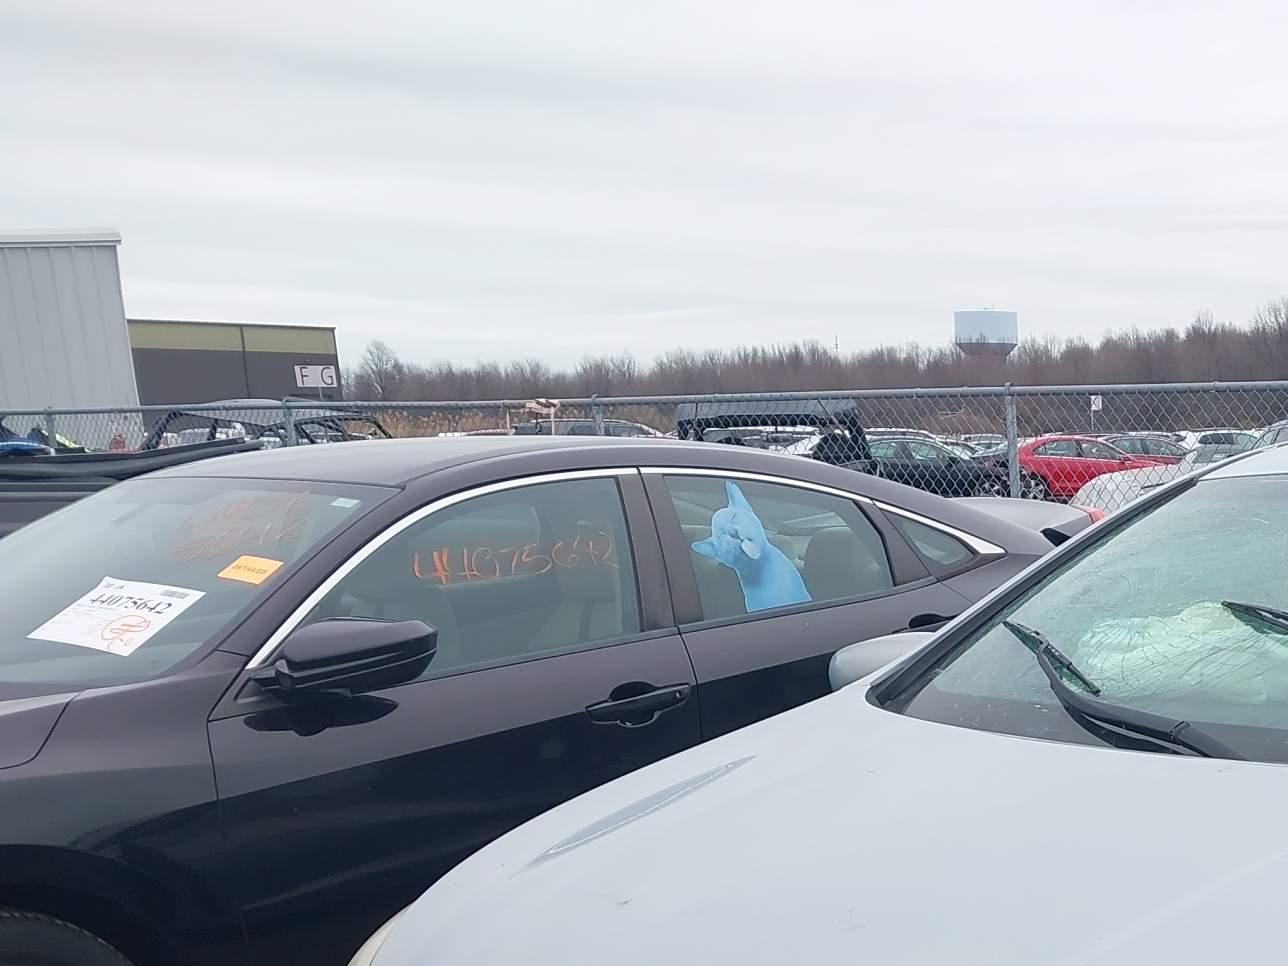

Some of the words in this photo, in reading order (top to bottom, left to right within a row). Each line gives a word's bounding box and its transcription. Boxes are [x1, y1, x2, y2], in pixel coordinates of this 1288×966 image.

[299, 366, 310, 386] F
[320, 366, 335, 386] G
[231, 563, 268, 576] DETAILED
[90, 592, 173, 615] 44075642
